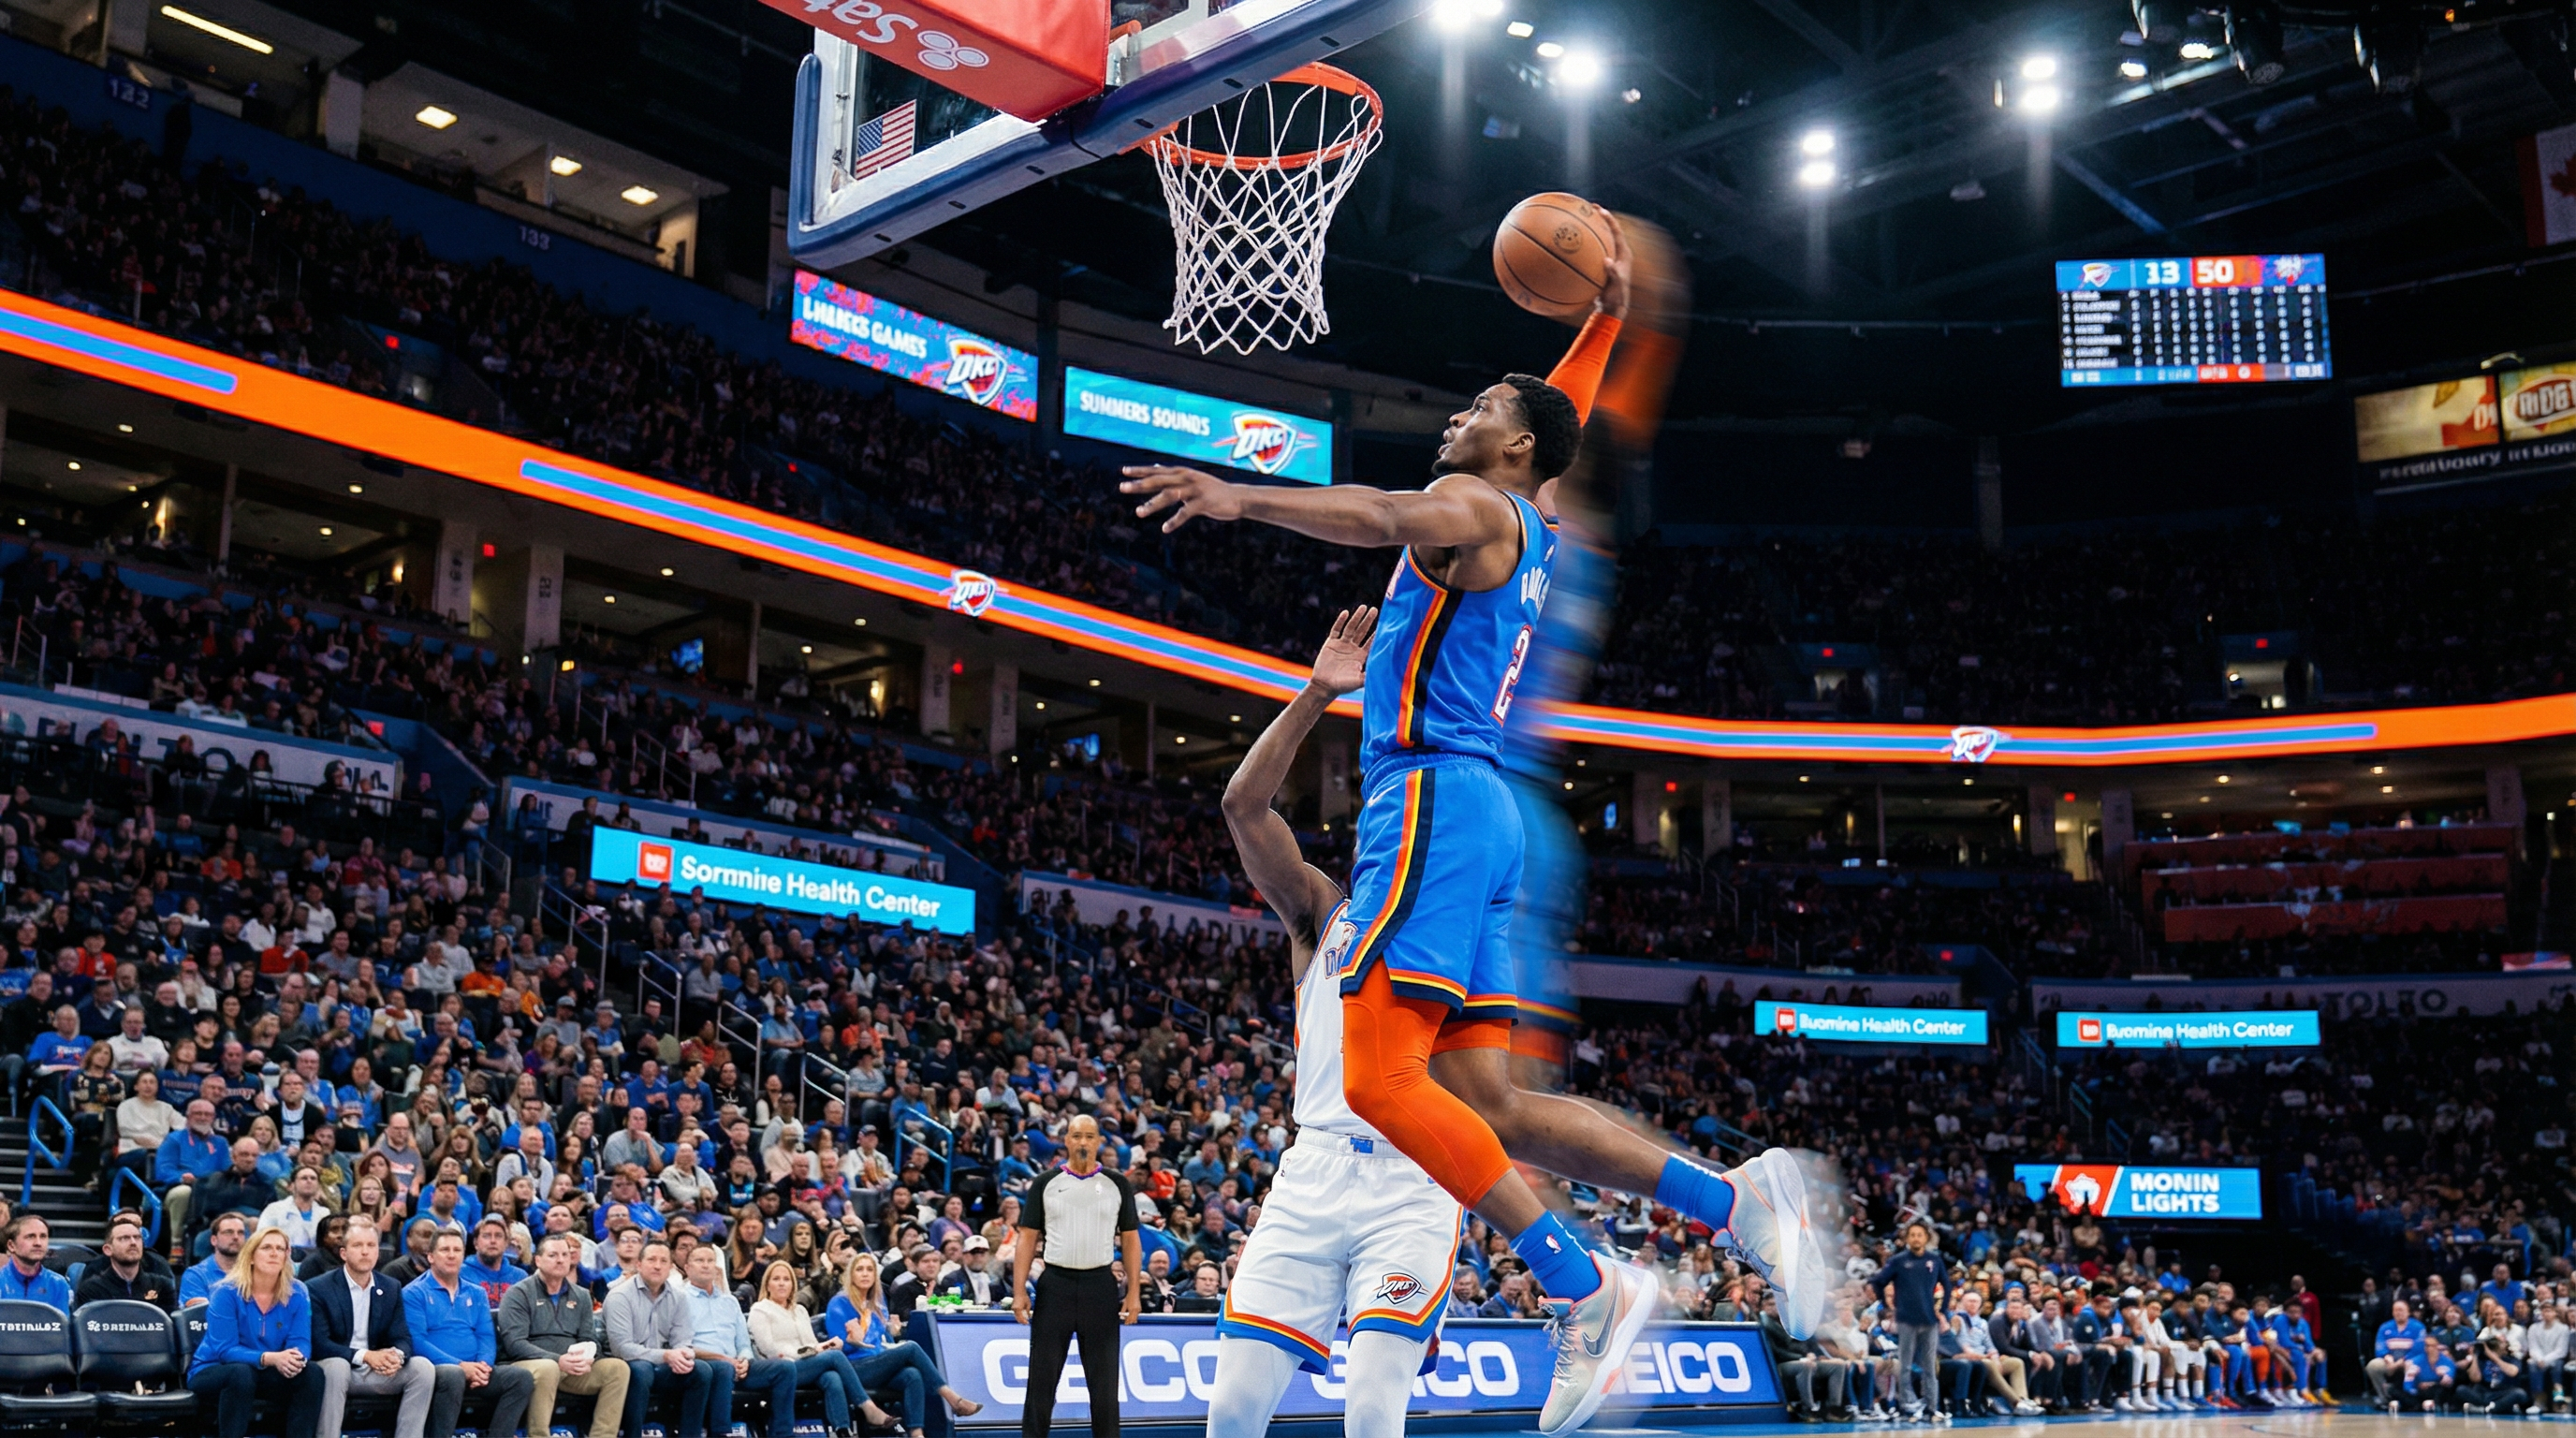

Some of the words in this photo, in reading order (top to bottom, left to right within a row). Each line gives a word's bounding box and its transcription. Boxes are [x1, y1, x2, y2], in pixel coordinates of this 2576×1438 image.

[2196, 257, 2234, 284] 50
[1152, 405, 1210, 437] SOUNDS
[786, 873, 860, 905] Health
[866, 886, 941, 917] Center
[1862, 1017, 1910, 1034] Health
[1912, 1018, 1966, 1034] Center
[2176, 1022, 2230, 1038] Health
[2232, 1021, 2293, 1038] Center
[2130, 1172, 2219, 1193] MONIN
[2131, 1193, 2220, 1213] LIGHTS
